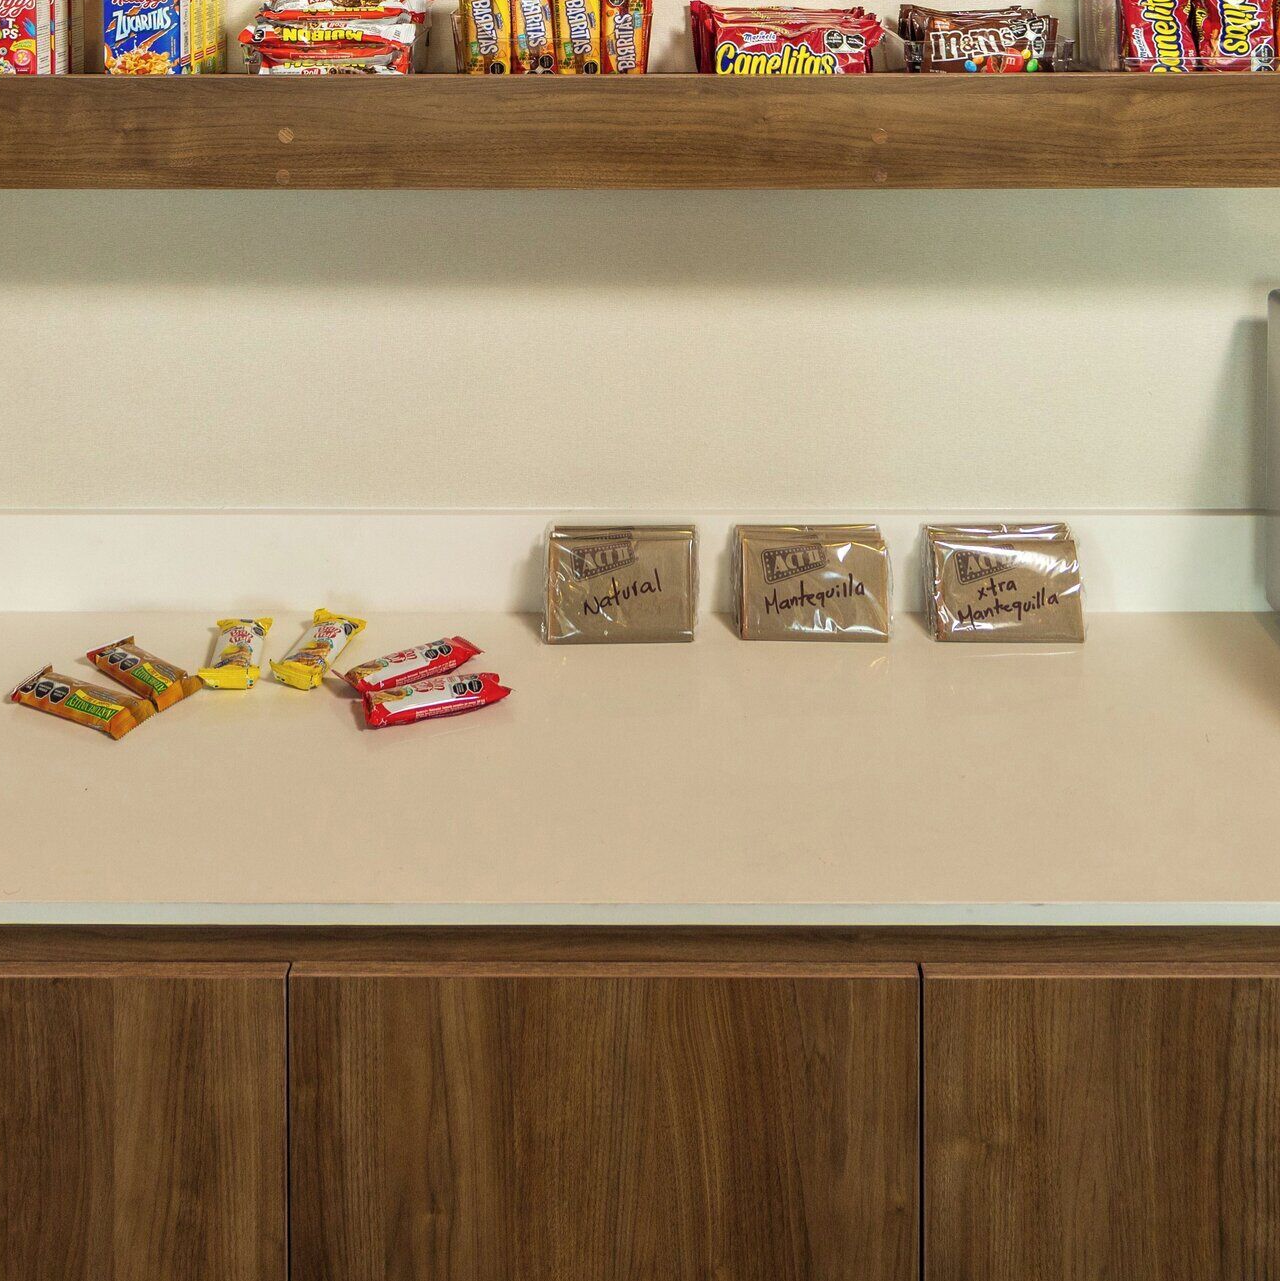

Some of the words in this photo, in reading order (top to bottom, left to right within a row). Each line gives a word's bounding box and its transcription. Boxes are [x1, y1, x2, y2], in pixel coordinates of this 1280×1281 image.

[112, 7, 172, 41] ZUCARITAS
[743, 32, 777, 41] Marinela
[614, 13, 636, 71] BARRITAS
[716, 42, 837, 74] Canelitas
[930, 28, 1015, 62] m&m's
[584, 548, 615, 572] ACT
[774, 551, 805, 573] ACT
[583, 568, 662, 615] Natural
[764, 573, 865, 614] Mantequilla
[978, 577, 1017, 600] xtra
[957, 587, 1059, 631] Mantequilla
